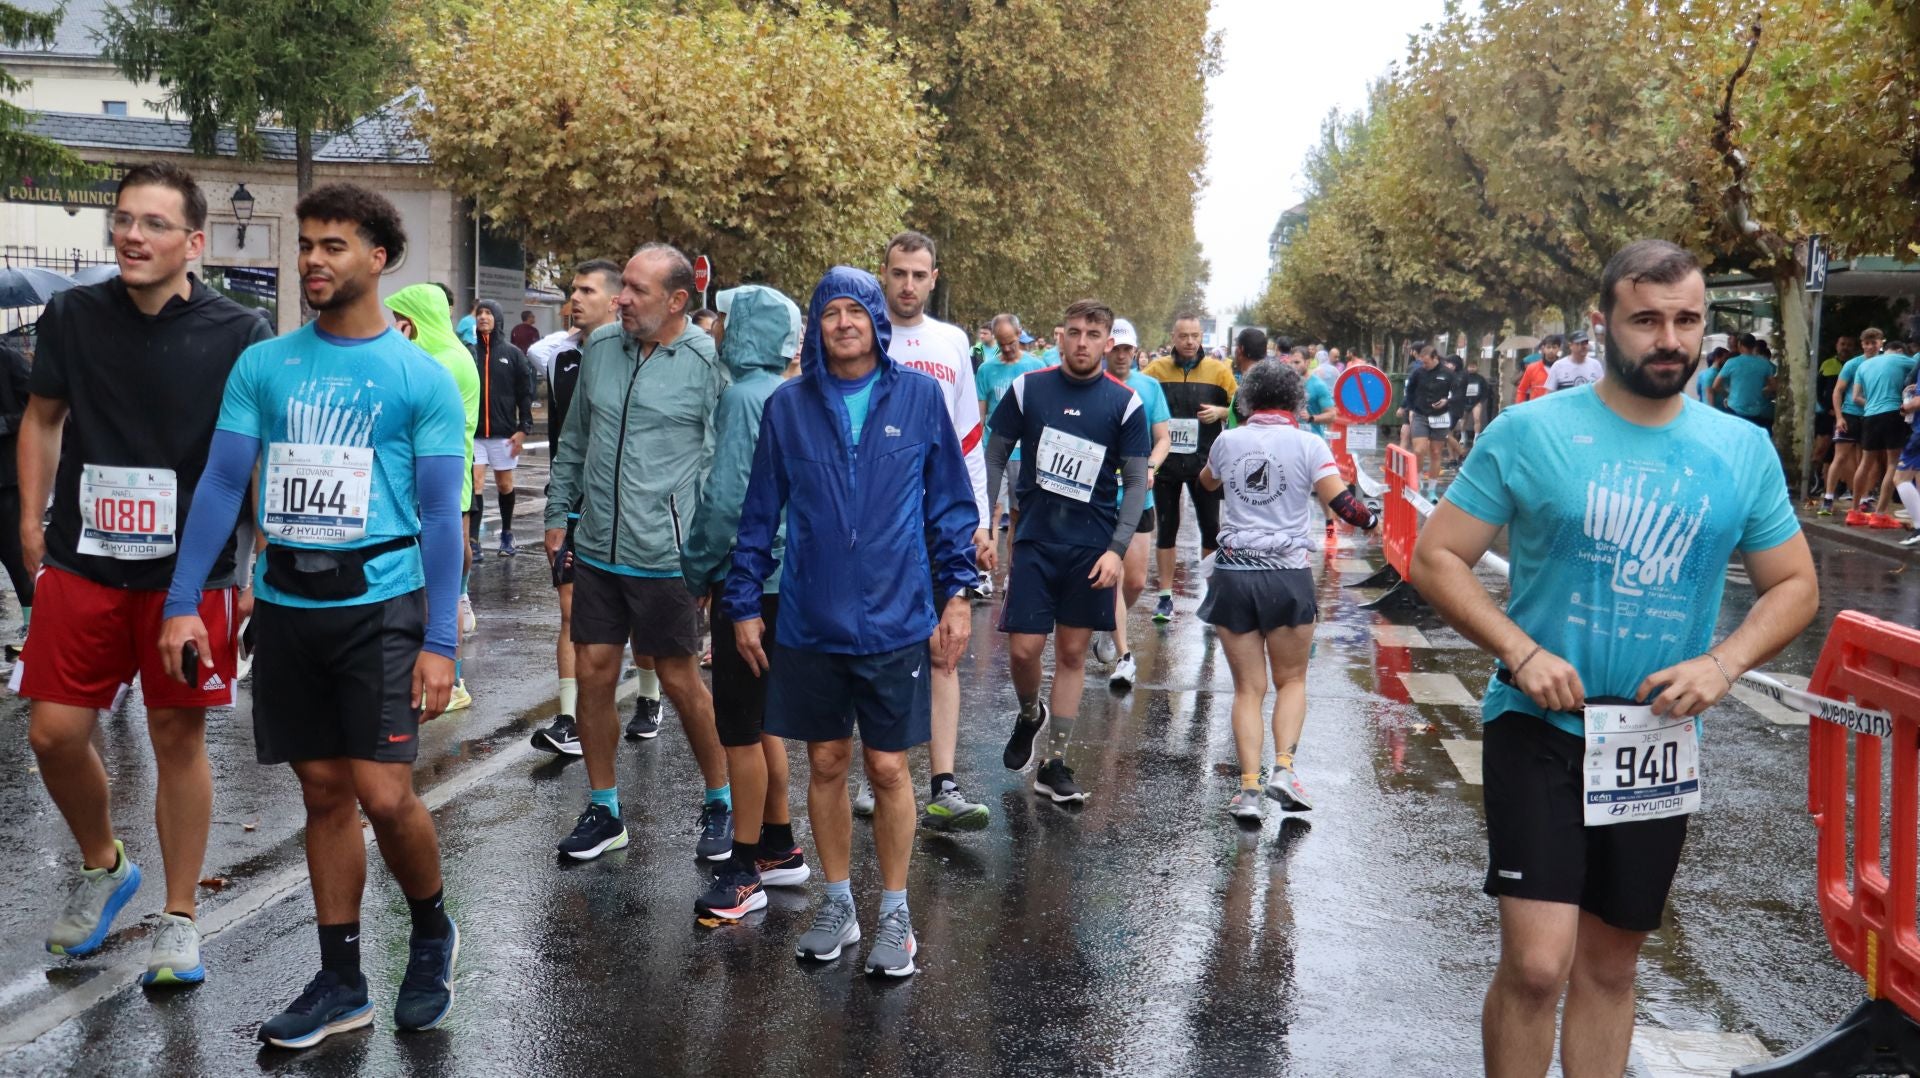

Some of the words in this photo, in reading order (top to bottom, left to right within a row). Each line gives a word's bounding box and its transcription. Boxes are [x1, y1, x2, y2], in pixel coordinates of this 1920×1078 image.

[695, 269, 707, 278] STOP
[1063, 408, 1081, 416] FILA
[1168, 430, 1189, 443] 014
[296, 468, 335, 477] GIOVANNI
[1049, 452, 1083, 481] 1141
[282, 477, 347, 516] 1044
[95, 497, 155, 533] 1080
[296, 526, 347, 538] HYUNDAI
[109, 543, 157, 554] HYUNDAI
[1619, 713, 1626, 723] k
[1615, 741, 1678, 788] 940
[1631, 797, 1684, 813] HYUNDAI
